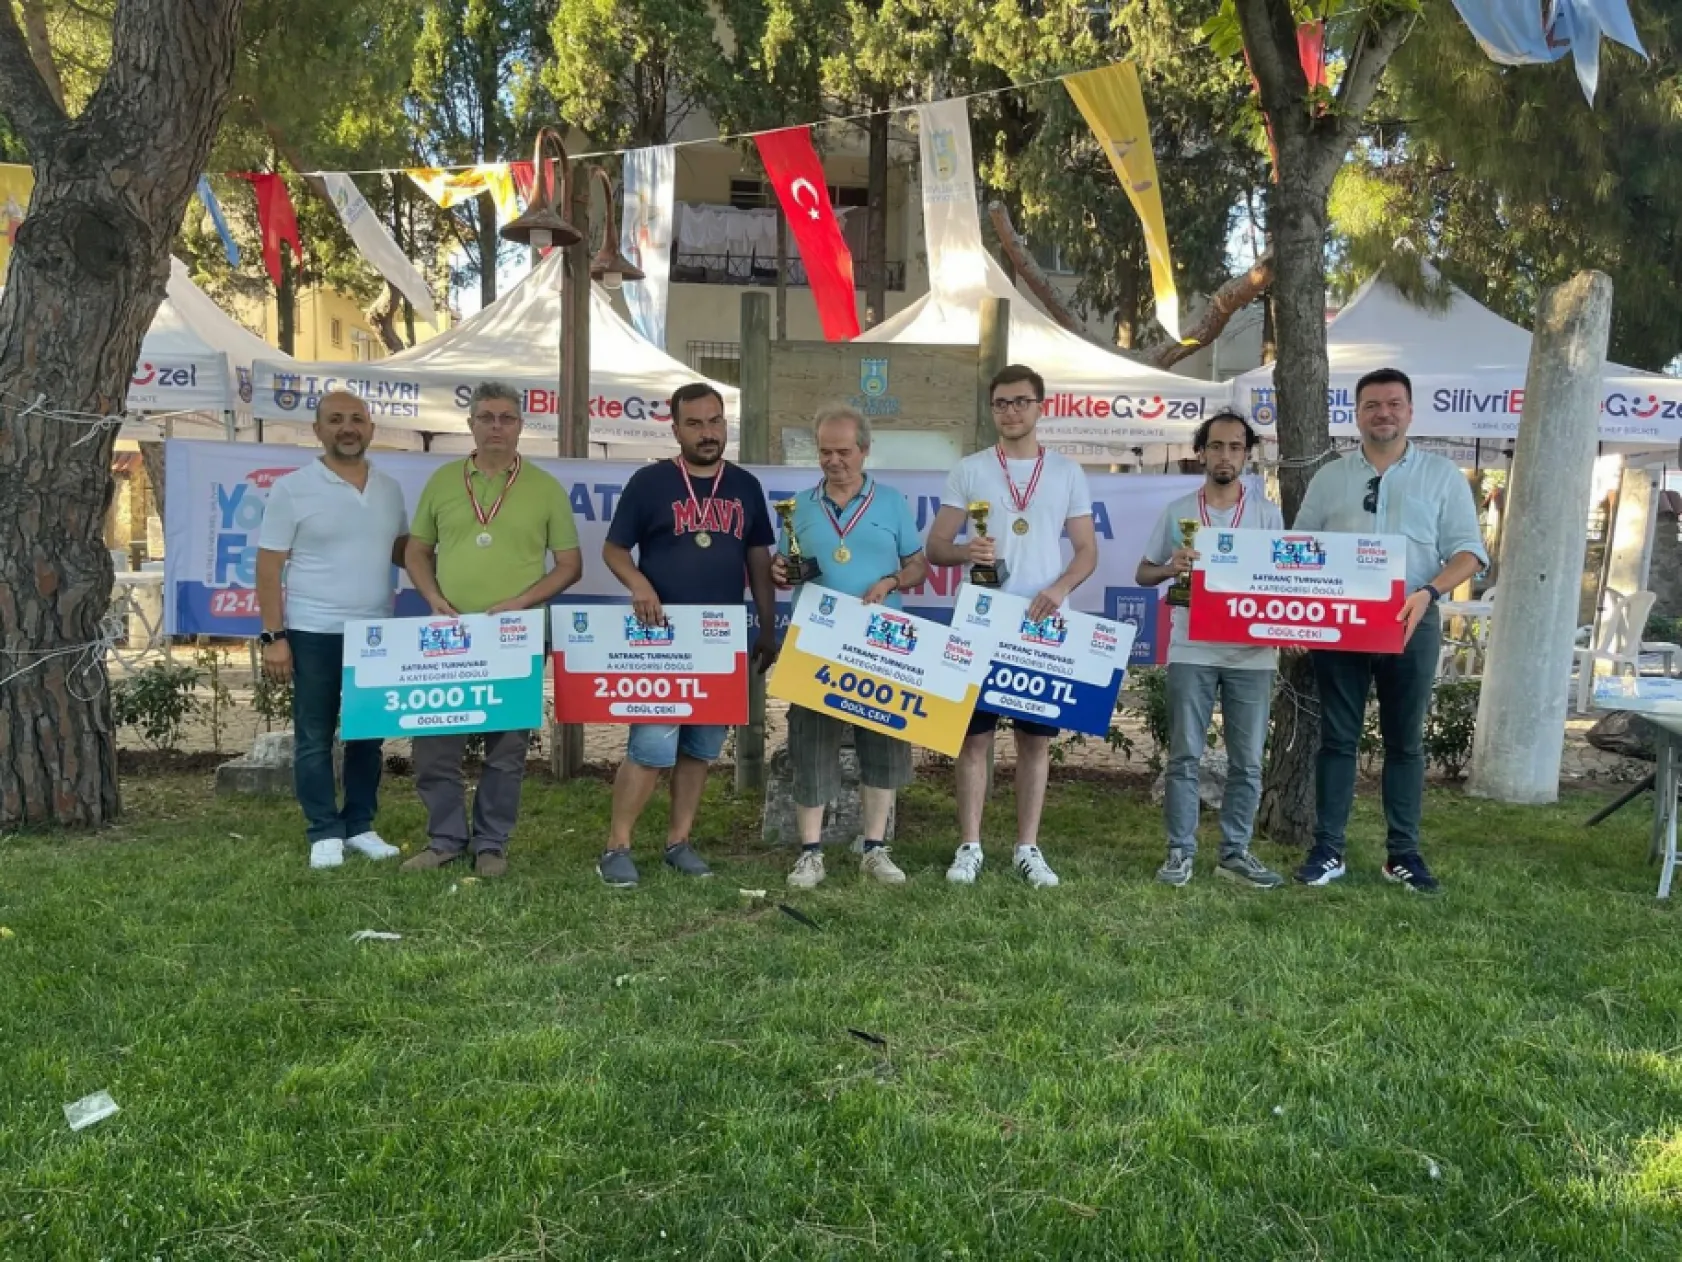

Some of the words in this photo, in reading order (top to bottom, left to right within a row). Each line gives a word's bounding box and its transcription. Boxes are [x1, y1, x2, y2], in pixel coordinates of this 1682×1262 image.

[1226, 598, 1325, 623] 10.000
[1330, 603, 1366, 625] TL
[384, 687, 464, 711] 3.000
[470, 684, 503, 706] TL
[594, 678, 671, 698] 2.000
[675, 678, 708, 698] TL
[815, 664, 894, 705] 4.000
[899, 690, 928, 718] TL
[987, 666, 1046, 696] .000
[1050, 680, 1078, 705] TL
[626, 704, 652, 714] ÖDÜL
